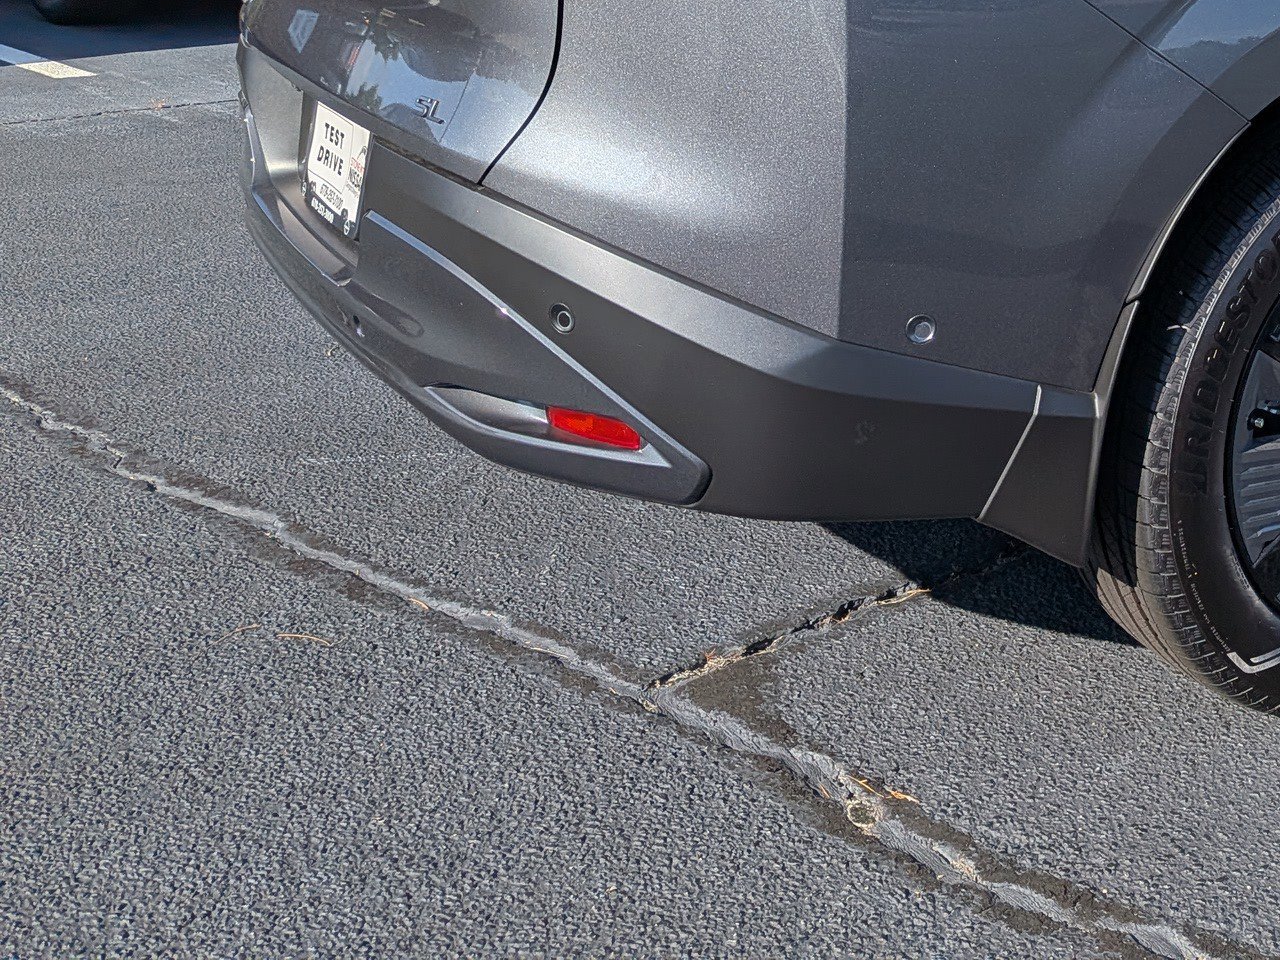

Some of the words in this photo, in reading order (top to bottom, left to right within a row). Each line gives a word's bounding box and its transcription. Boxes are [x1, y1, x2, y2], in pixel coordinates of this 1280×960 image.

[415, 95, 445, 124] SL
[325, 123, 345, 149] TEST
[316, 146, 343, 176] DRIVE
